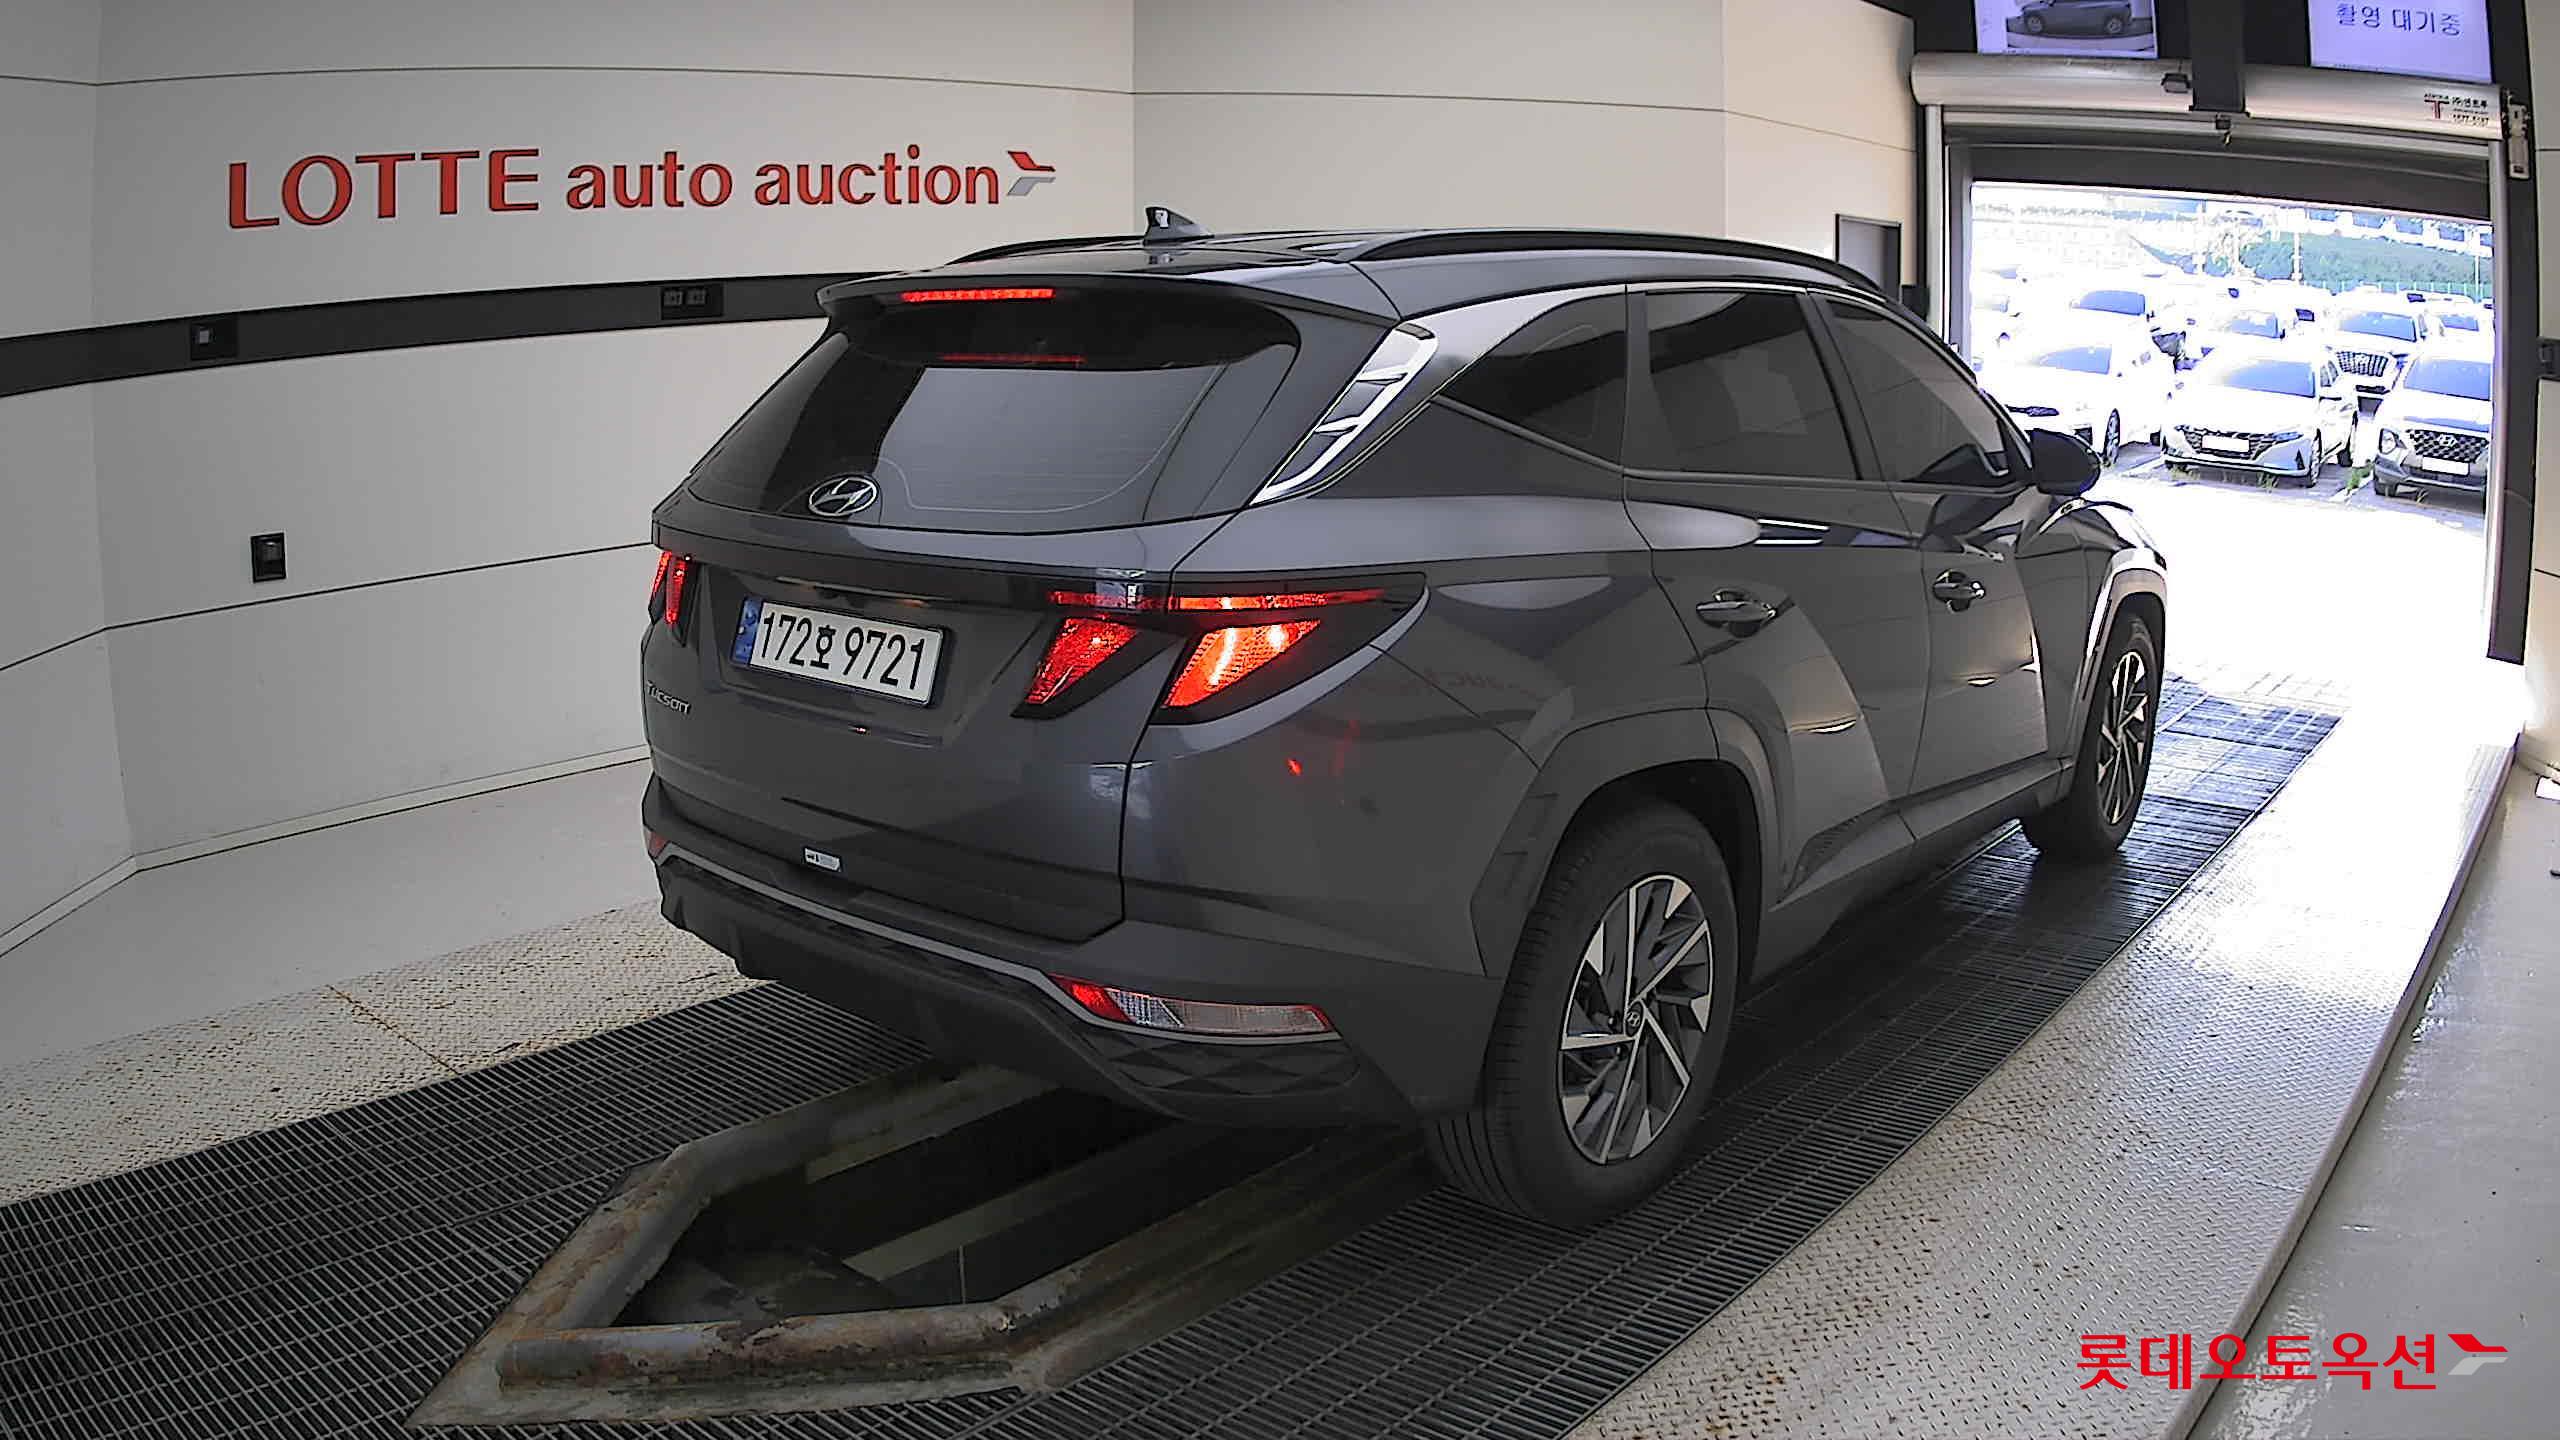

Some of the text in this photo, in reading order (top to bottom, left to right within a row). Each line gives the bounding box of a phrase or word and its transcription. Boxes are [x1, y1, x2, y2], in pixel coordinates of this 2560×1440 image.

[2392, 8, 2460, 36] 대기중
[228, 144, 1000, 229] LOTTE auto auction
[762, 612, 926, 690] 172호 9721
